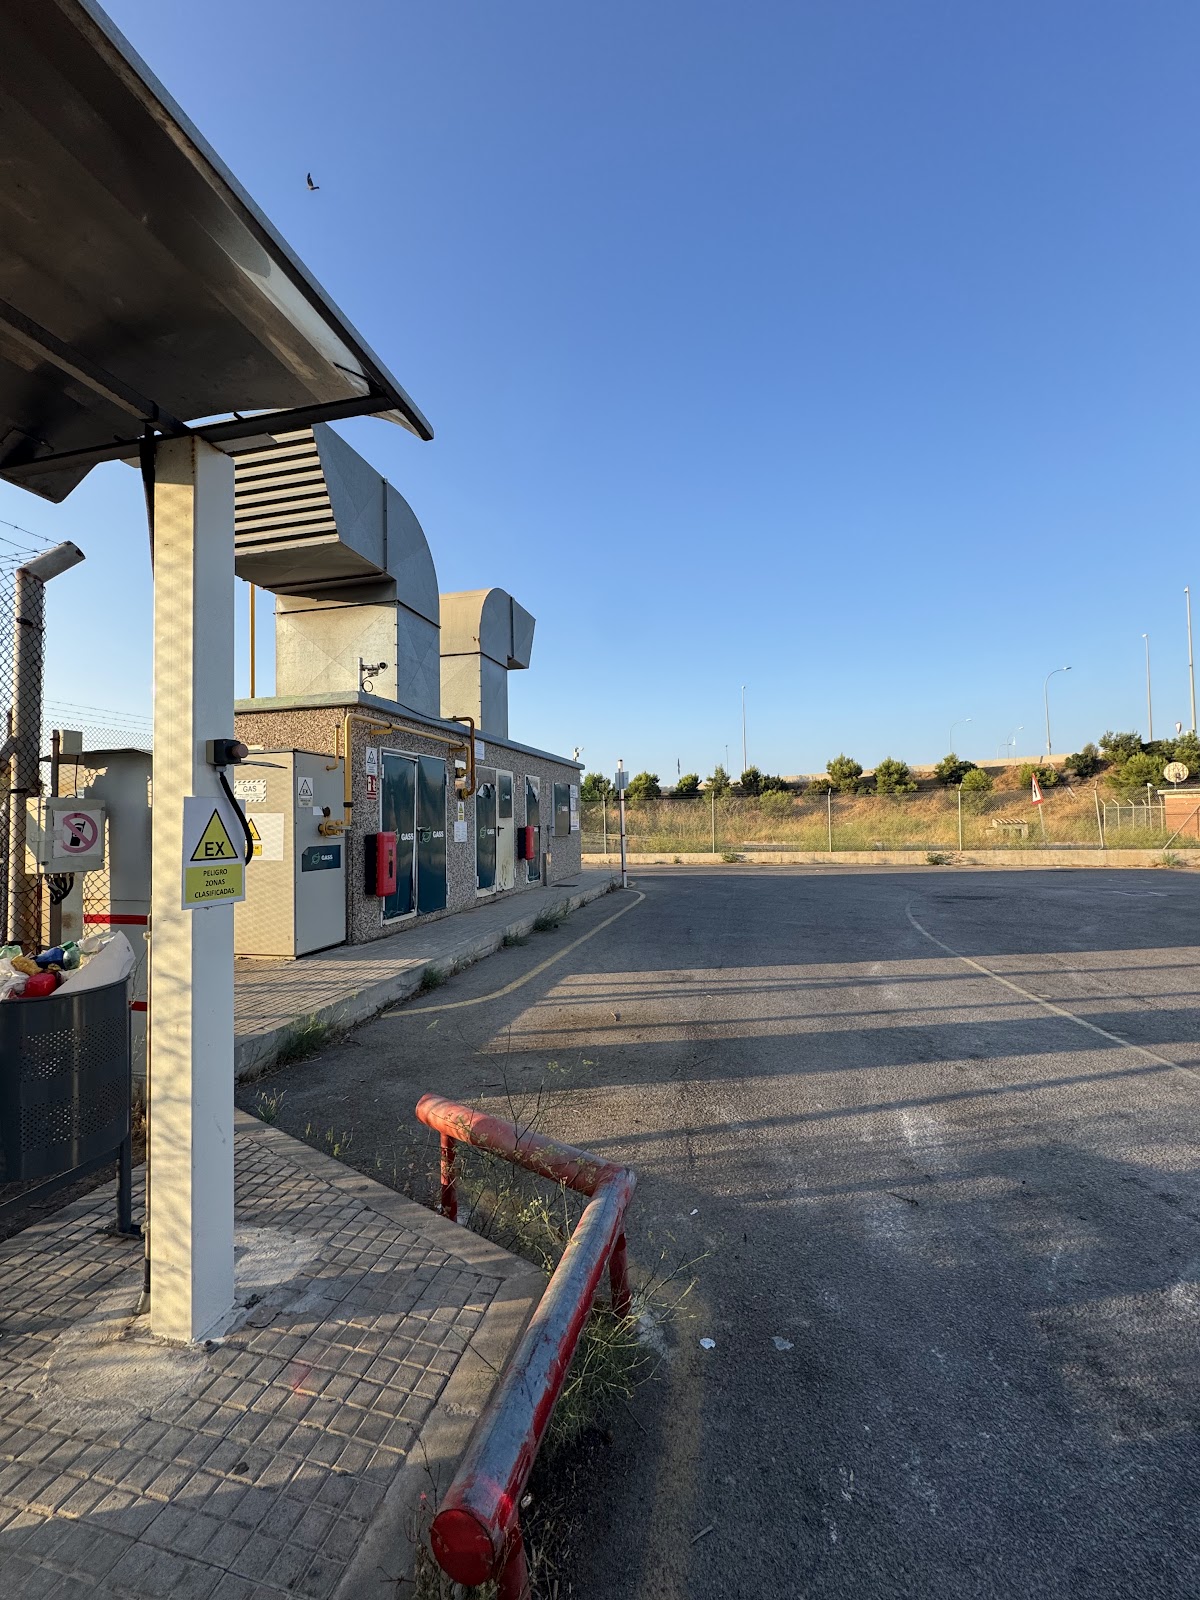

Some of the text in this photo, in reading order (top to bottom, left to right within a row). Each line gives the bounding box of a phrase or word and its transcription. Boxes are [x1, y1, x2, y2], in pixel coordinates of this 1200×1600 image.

[243, 785, 257, 793] GAS
[401, 833, 414, 841] GASS
[204, 842, 225, 857] EX
[203, 868, 228, 877] PELIGRO
[205, 879, 226, 887] ZONAS
[194, 887, 235, 899] CLASIFICADAS
